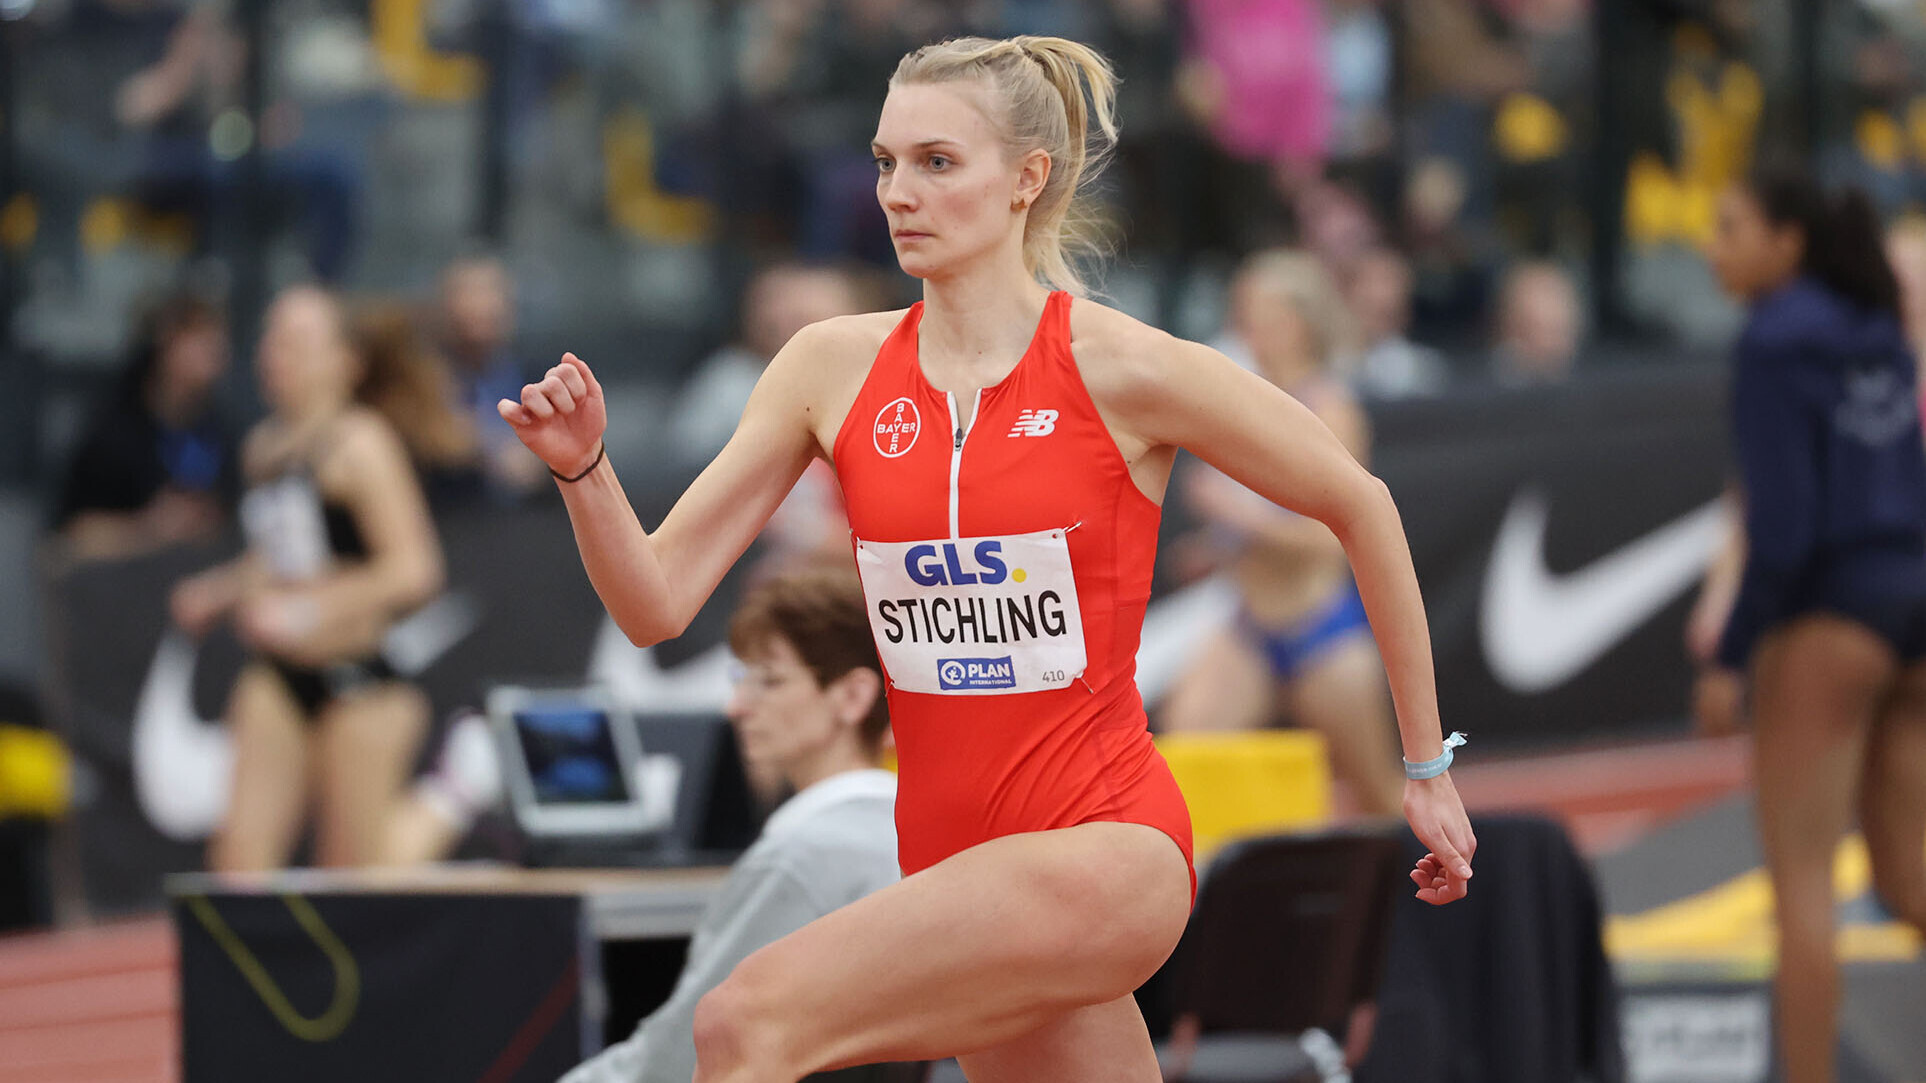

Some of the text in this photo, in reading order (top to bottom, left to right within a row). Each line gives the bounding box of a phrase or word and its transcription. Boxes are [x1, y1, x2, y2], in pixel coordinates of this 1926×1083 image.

[877, 422, 916, 434] BAYER
[889, 403, 905, 453] BAYER
[878, 590, 1067, 644] STICHLING
[968, 663, 1010, 678] PLAN
[1042, 670, 1065, 682] 410
